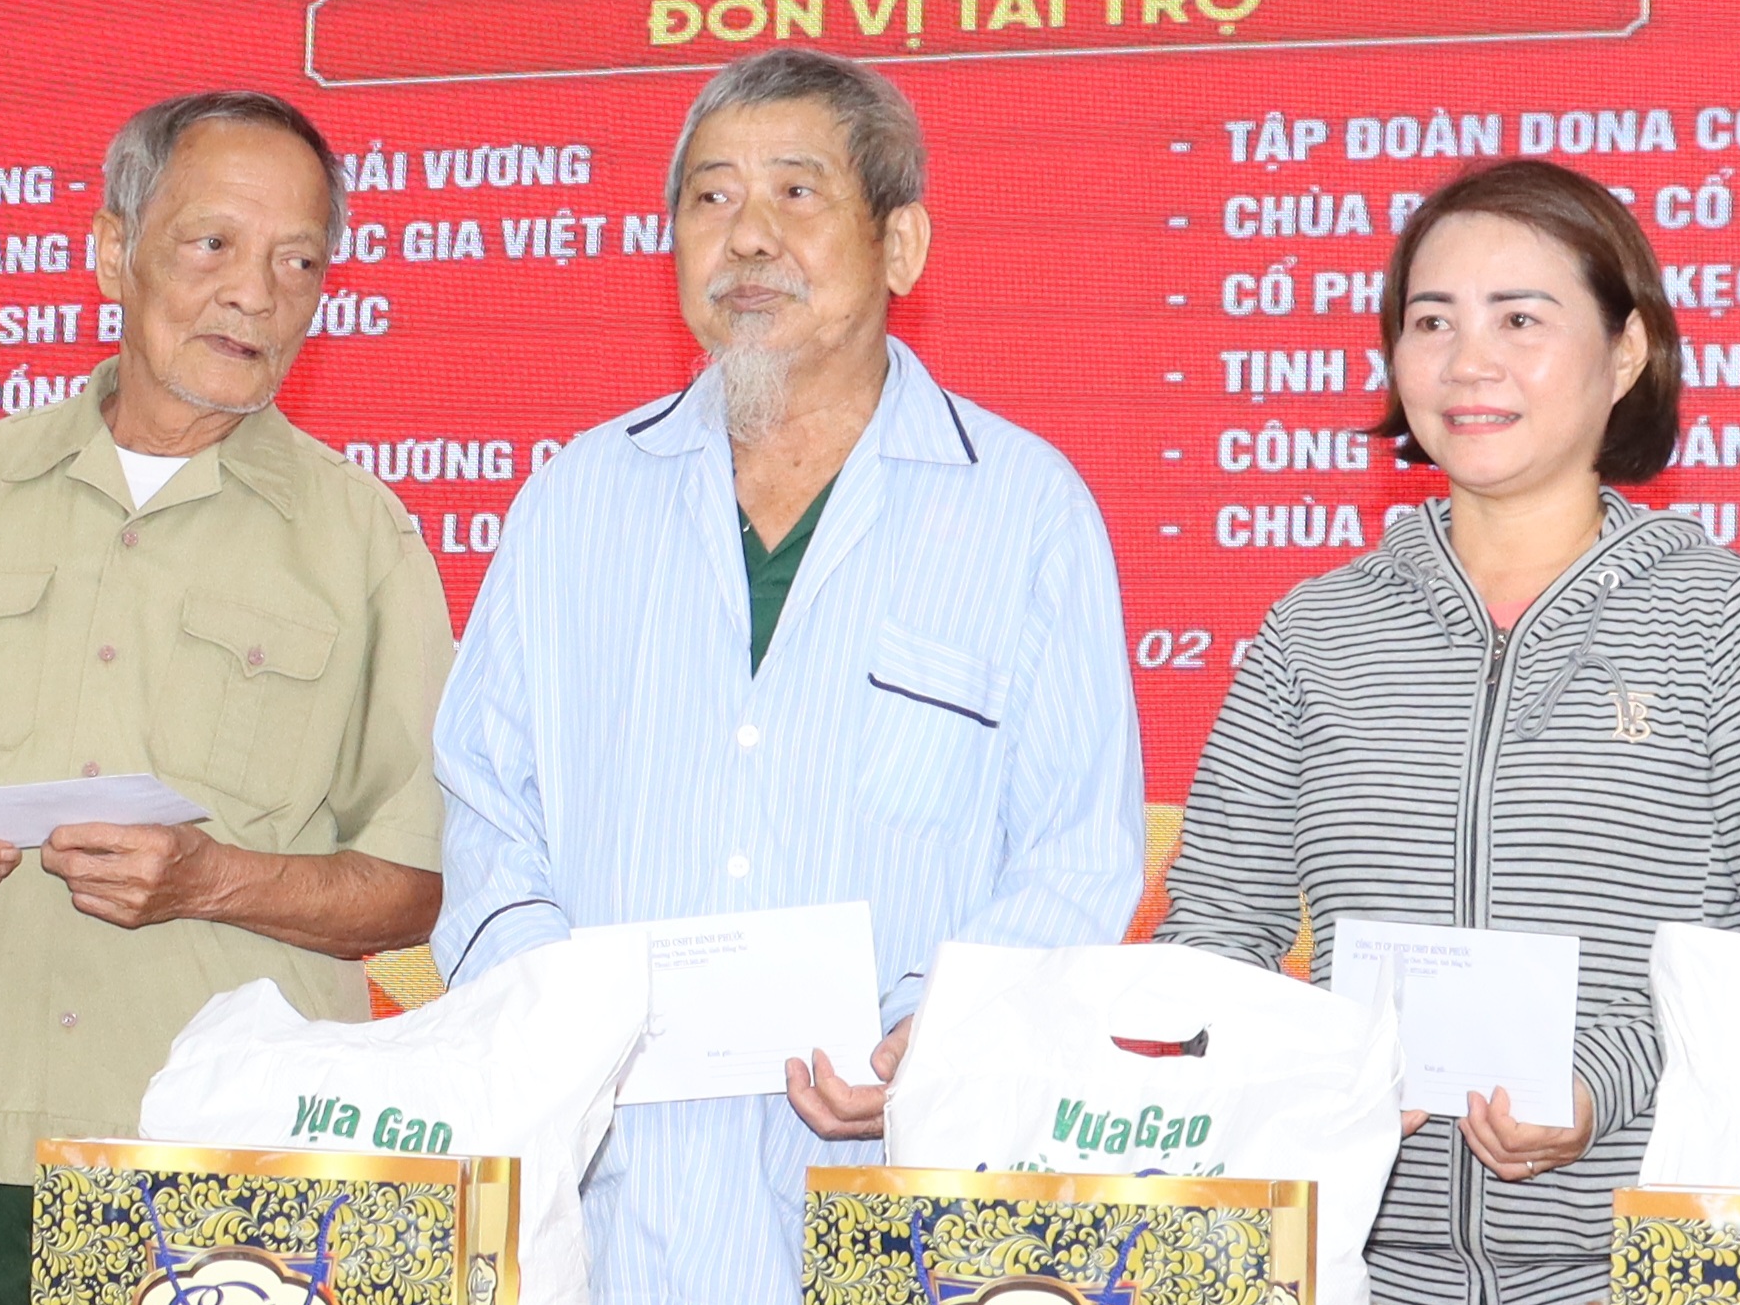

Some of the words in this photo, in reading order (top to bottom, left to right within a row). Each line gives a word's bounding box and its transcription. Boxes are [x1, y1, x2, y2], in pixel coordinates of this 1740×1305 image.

[1225, 111, 1328, 171] TẬP
[1345, 107, 1501, 160] ĐOÀN
[1520, 109, 1677, 155] DONA
[423, 143, 591, 190] VƯƠNG
[1224, 185, 1372, 239] CHÙA
[1655, 167, 1734, 230] CỔ
[403, 220, 485, 262] GIA
[501, 208, 607, 266] VIỆT
[306, 289, 389, 336] ƯỚC
[1222, 256, 1297, 316] CỔ
[1220, 349, 1345, 402] TỊNH
[1218, 419, 1369, 472] CÔNG
[1216, 496, 1364, 548] CHÙA
[1136, 629, 1211, 668] 02
[1051, 1098, 1133, 1159] Vựa
[1134, 1105, 1214, 1154] Gạo
